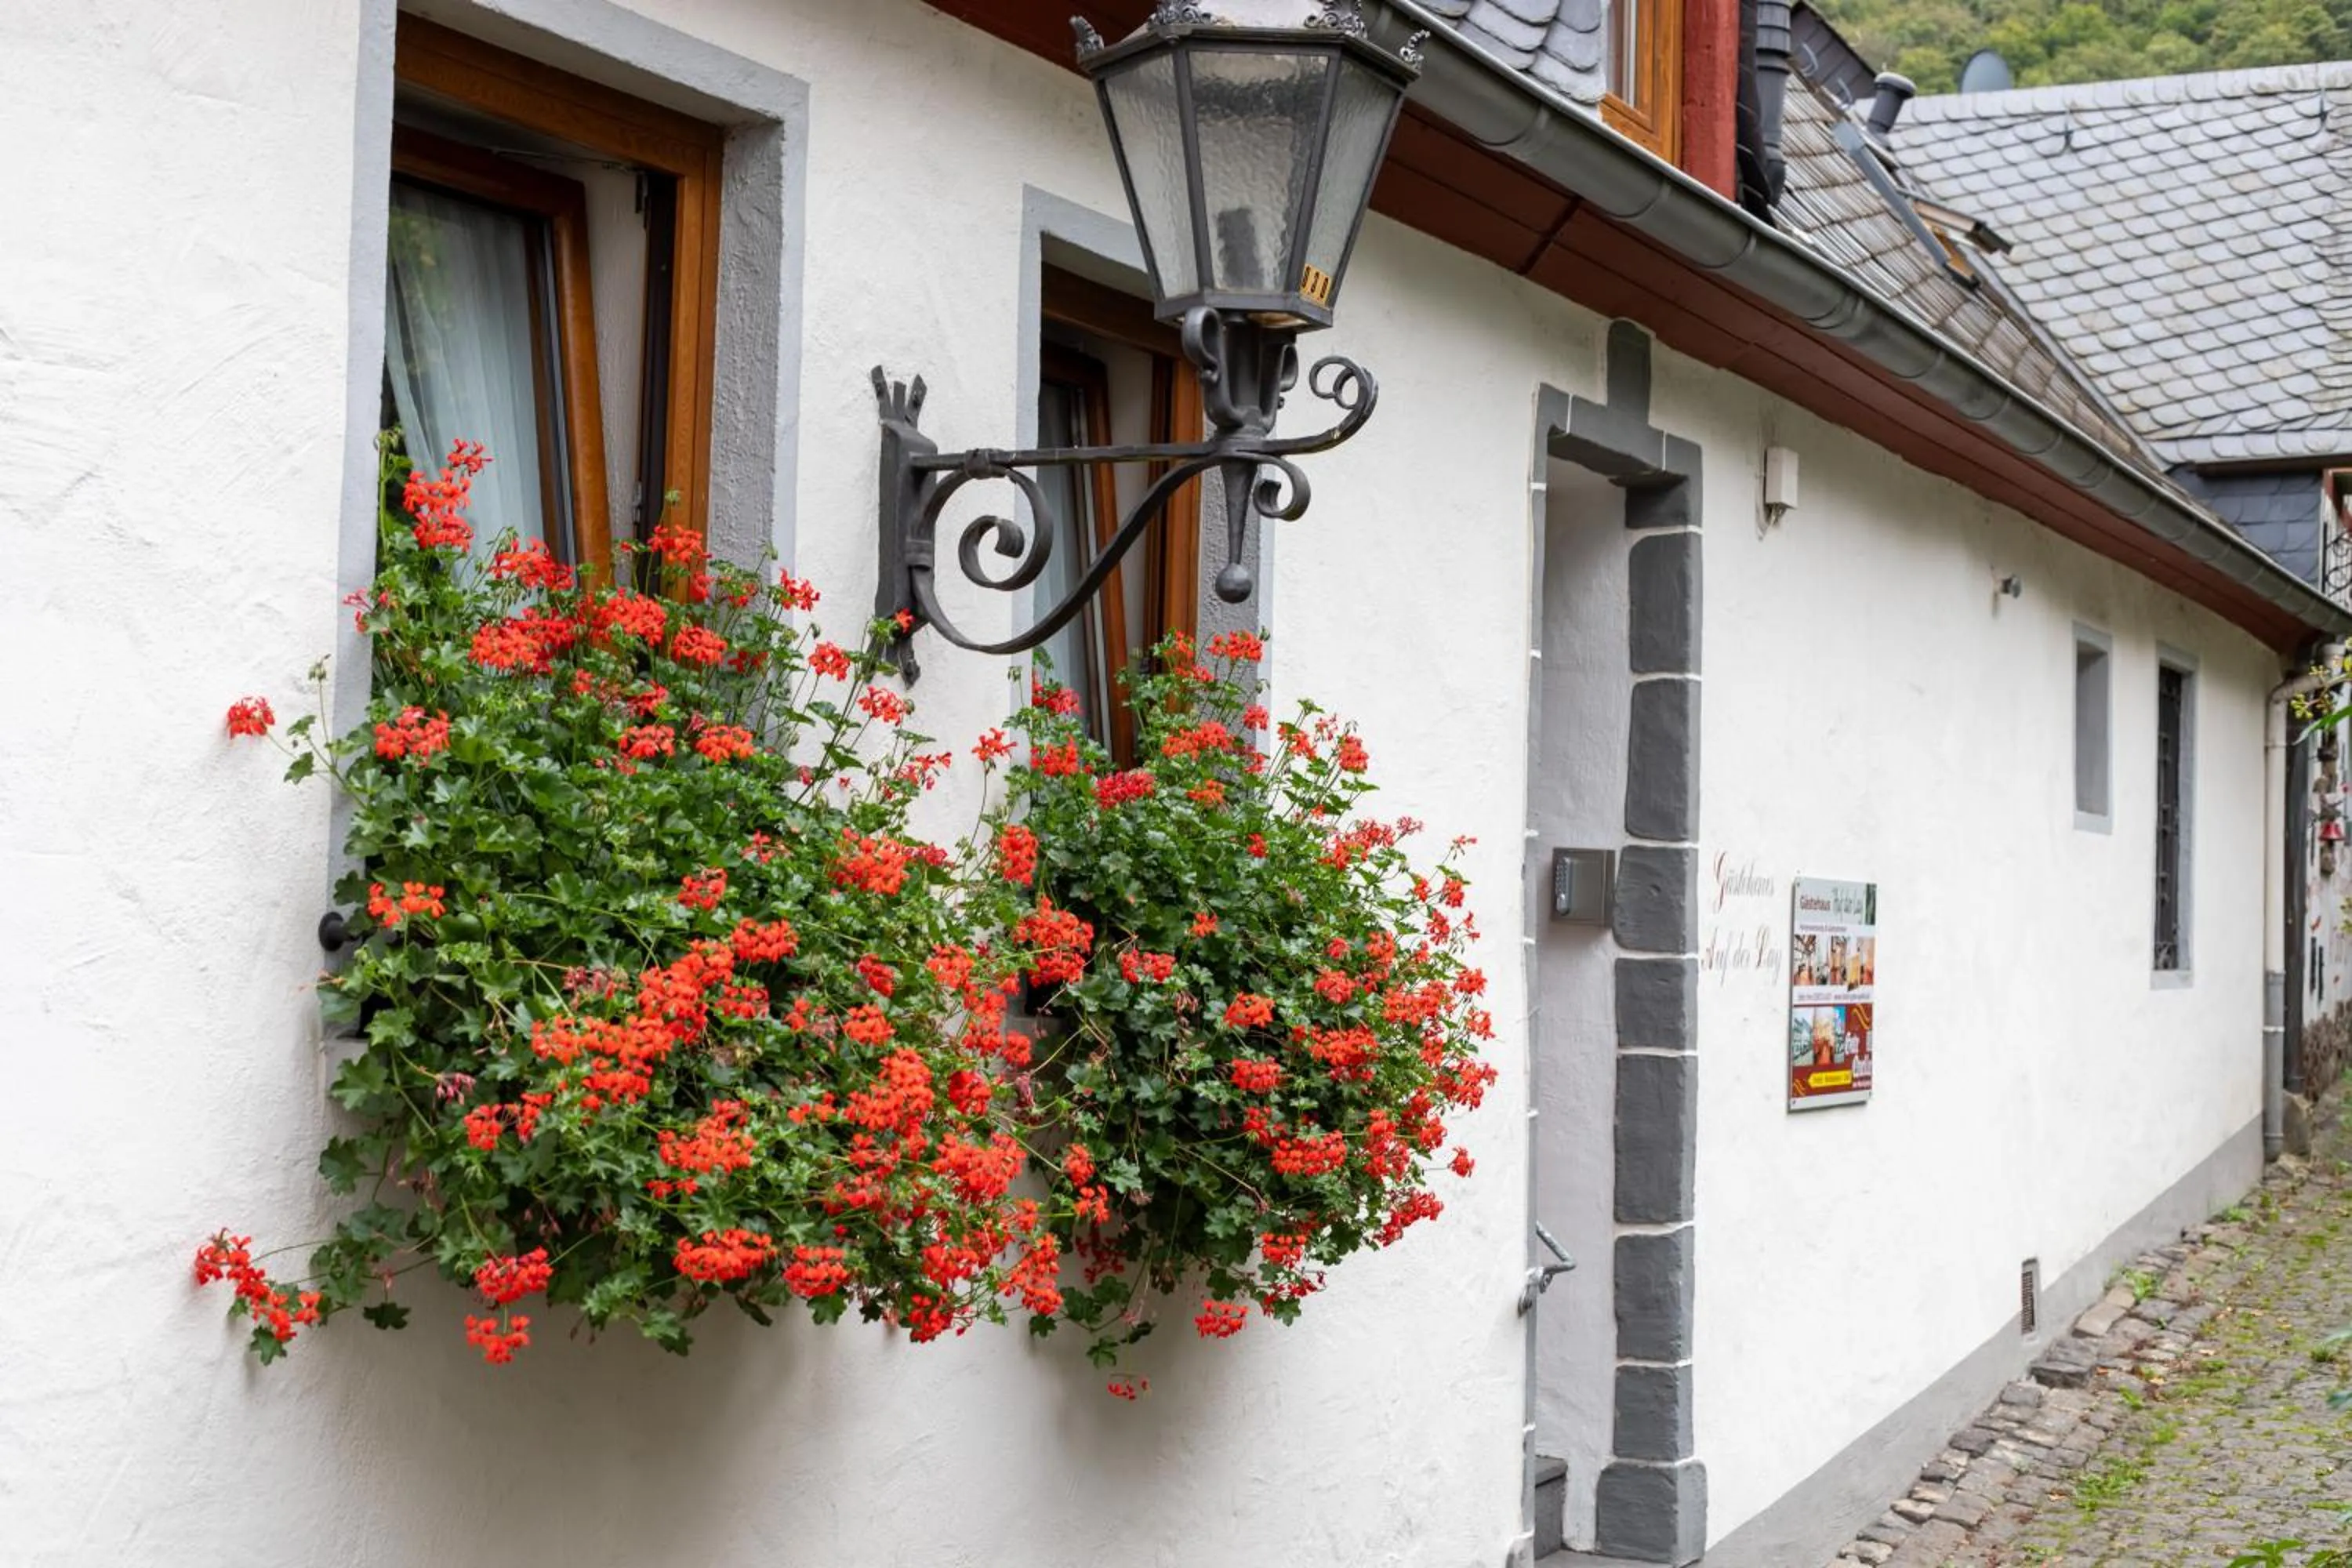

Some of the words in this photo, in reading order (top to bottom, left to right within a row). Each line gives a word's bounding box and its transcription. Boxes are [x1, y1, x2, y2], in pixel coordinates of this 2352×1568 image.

[1713, 850, 1774, 915] Gästehaus
[1799, 895, 1831, 911] Gästehaus
[1700, 926, 1733, 986] Auf
[1733, 931, 1751, 968] der
